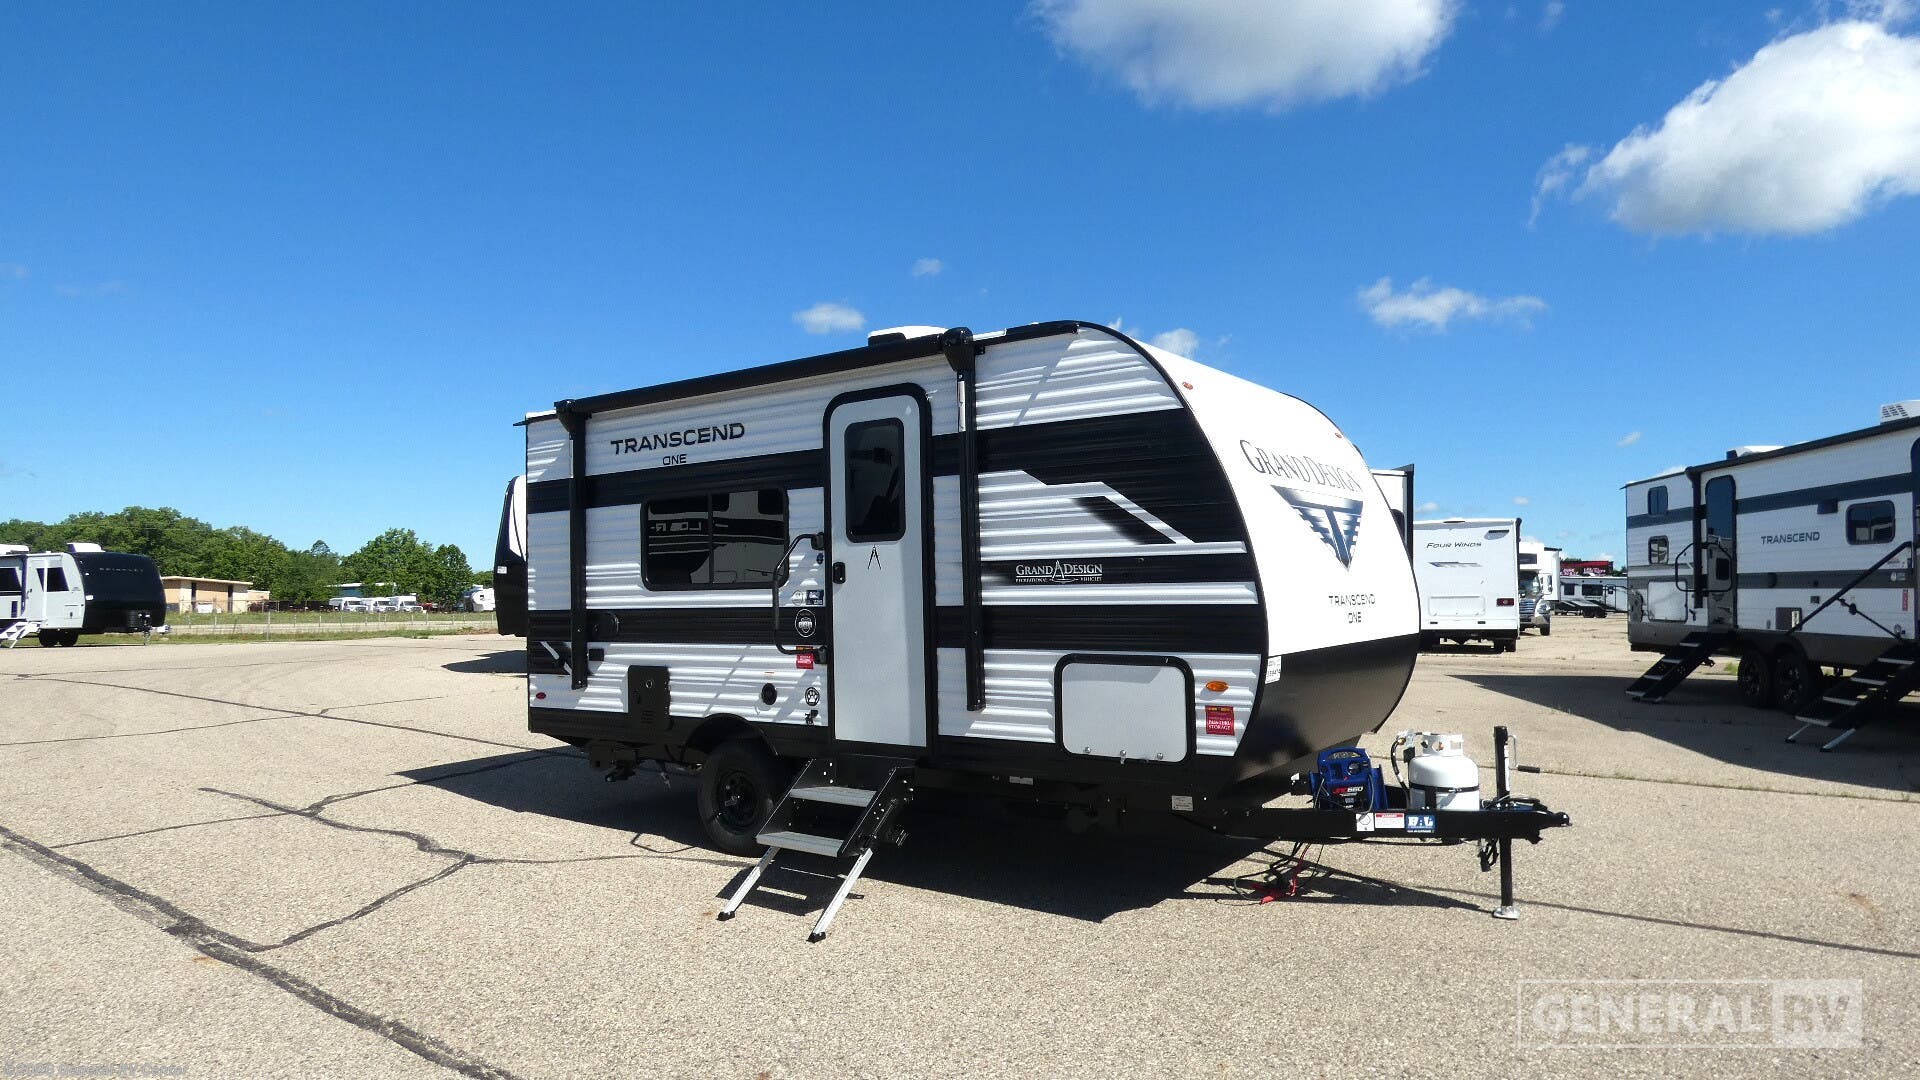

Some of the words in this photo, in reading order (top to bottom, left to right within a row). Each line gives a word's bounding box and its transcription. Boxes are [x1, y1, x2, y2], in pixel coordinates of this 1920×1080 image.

[611, 422, 745, 455] TRANSCEND
[662, 453, 687, 466] ONE
[1240, 440, 1311, 483] GRAND
[1303, 455, 1363, 492] DESIGN
[1760, 531, 1820, 545] TRANSCEND
[1015, 564, 1054, 576] GRAND
[1063, 563, 1103, 575] DESIGN
[1328, 594, 1376, 606] TRANSCEND
[1348, 611, 1362, 624] ONE
